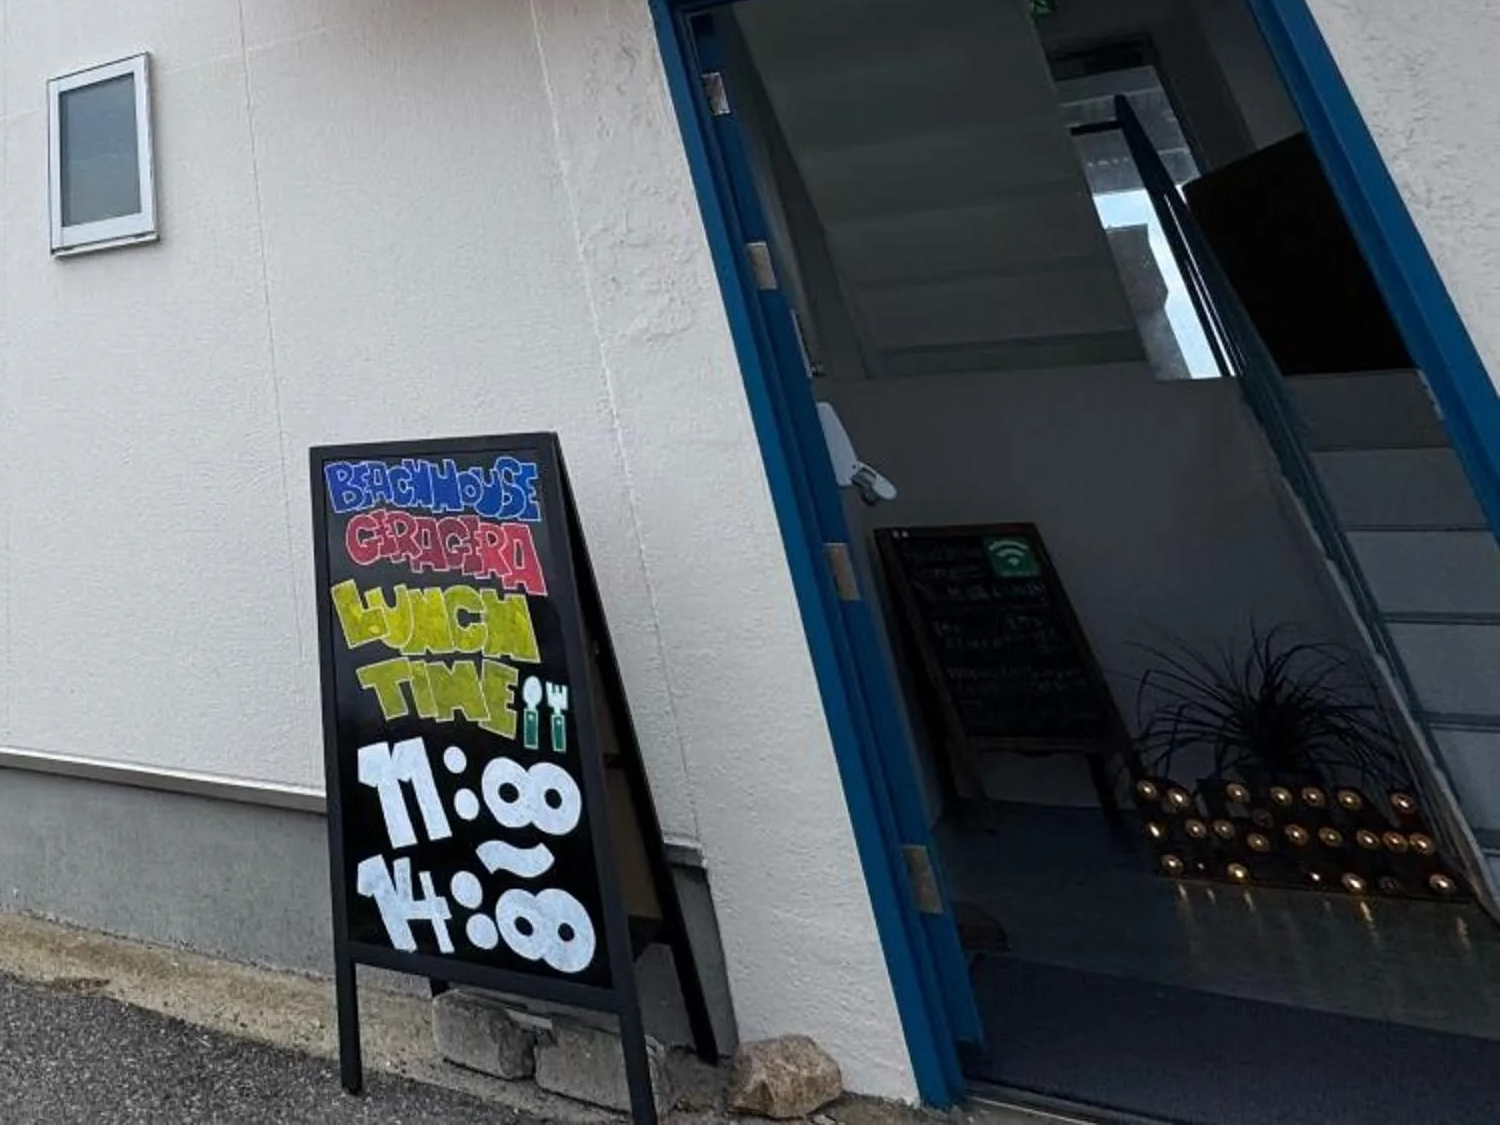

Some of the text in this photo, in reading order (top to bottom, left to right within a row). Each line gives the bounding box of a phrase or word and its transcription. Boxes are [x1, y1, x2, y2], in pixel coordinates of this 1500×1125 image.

[345, 508, 549, 597] GERAGERA
[331, 578, 541, 664] LUNCH
[356, 657, 519, 740] TIME
[356, 735, 583, 849] 11:00
[355, 853, 597, 974] 14:00
